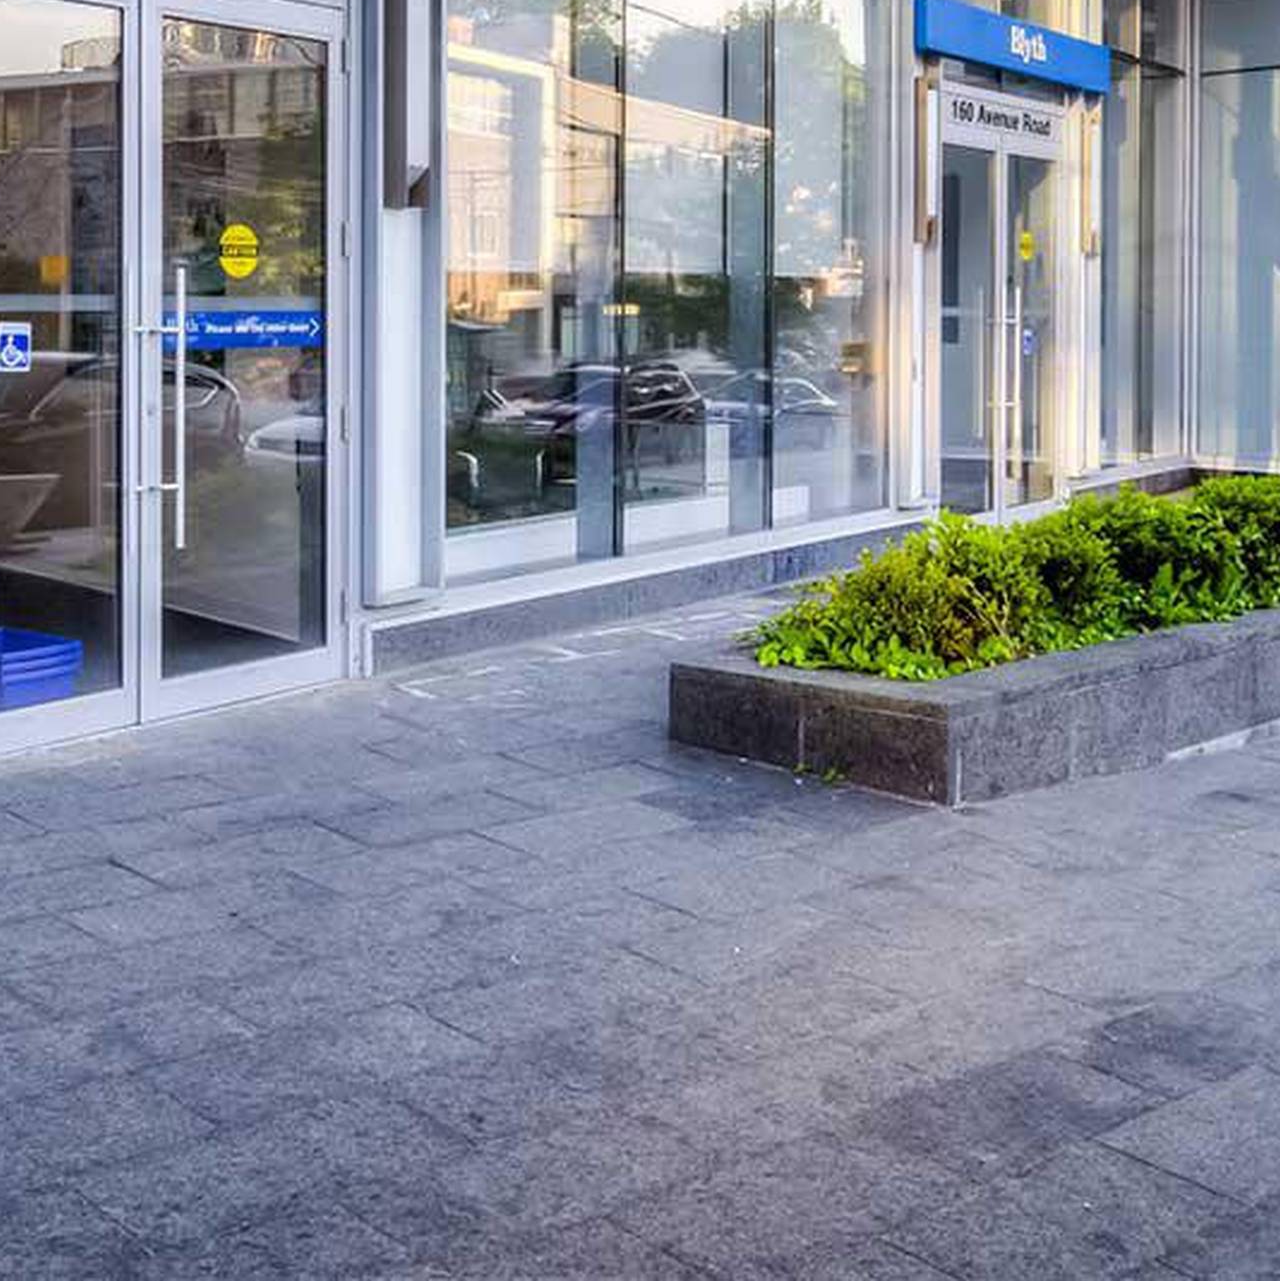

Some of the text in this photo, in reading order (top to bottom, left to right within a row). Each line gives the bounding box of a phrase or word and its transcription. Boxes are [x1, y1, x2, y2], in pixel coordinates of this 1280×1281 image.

[1011, 25, 1047, 64] Blyth
[952, 100, 1051, 136] 160 Avenue Road
